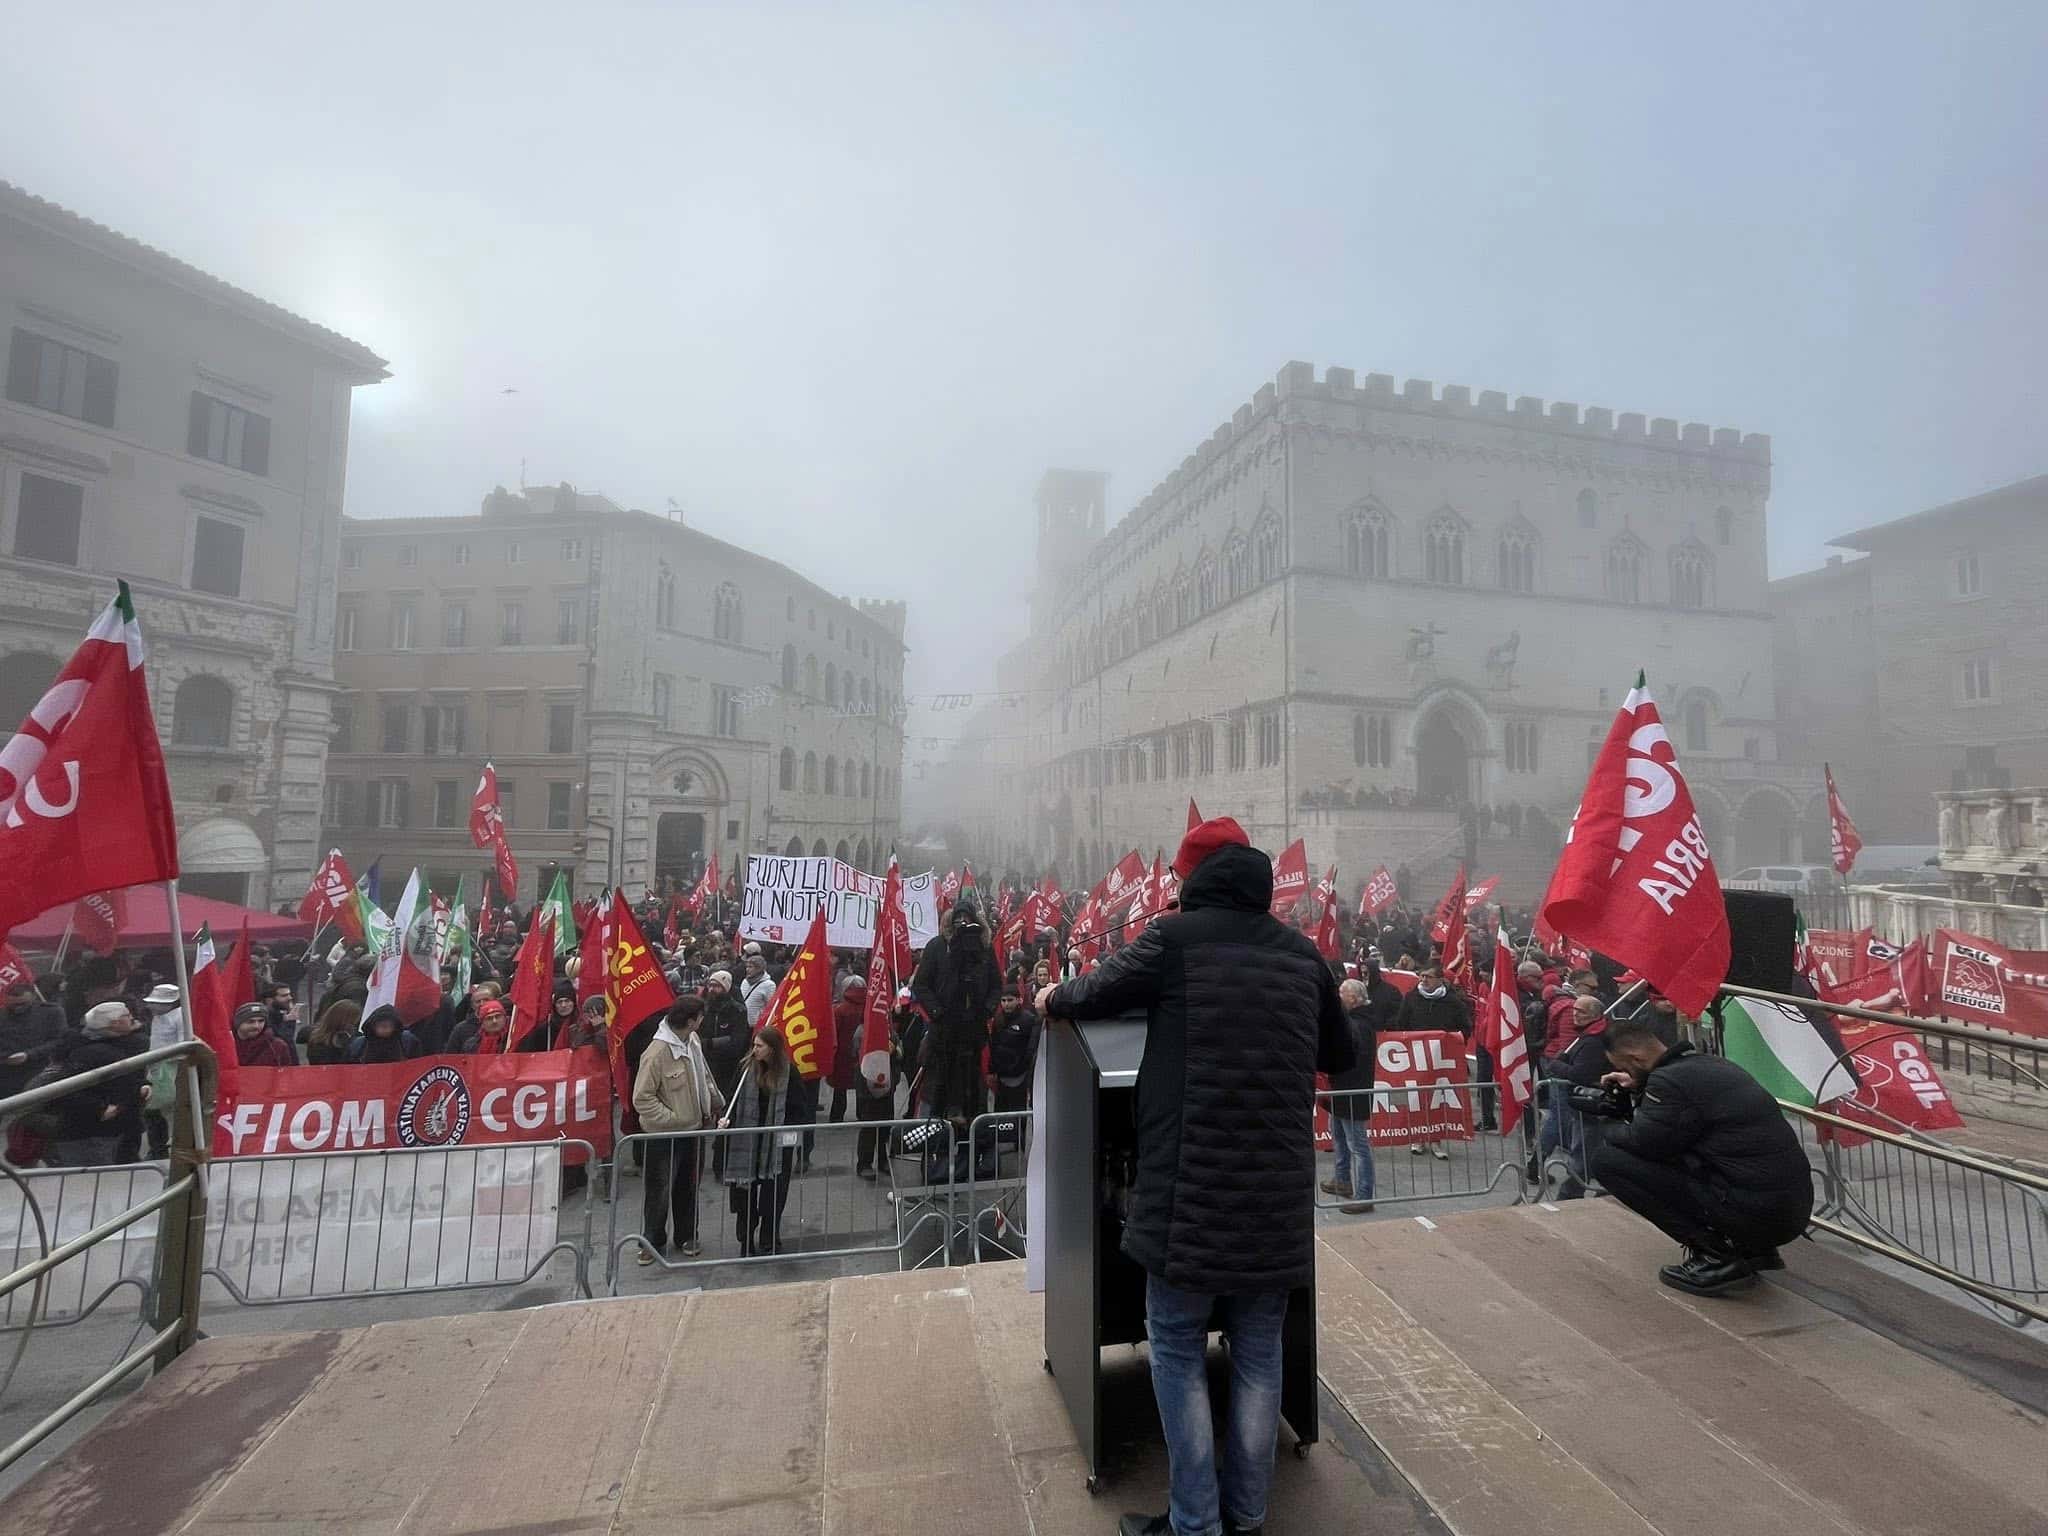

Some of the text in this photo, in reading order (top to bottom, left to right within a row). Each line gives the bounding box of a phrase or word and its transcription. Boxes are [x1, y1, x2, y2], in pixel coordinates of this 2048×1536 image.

[746, 856, 797, 889] FUORI
[801, 858, 827, 892] LA
[742, 887, 923, 931] DAL NOSTRO FUTO
[1811, 945, 1855, 958] AZIONE
[1944, 993, 2001, 1012] PERUGIA
[1945, 985, 2001, 1001] FILCAMS
[1377, 1039, 1457, 1073] GIL
[1893, 1040, 1947, 1110] CGIL
[402, 1068, 458, 1144] OSTINATAMENTE
[1372, 1077, 1463, 1113] RIA
[233, 1079, 597, 1154] FIOM CGIL
[1410, 1122, 1465, 1135] INDUSTRIA
